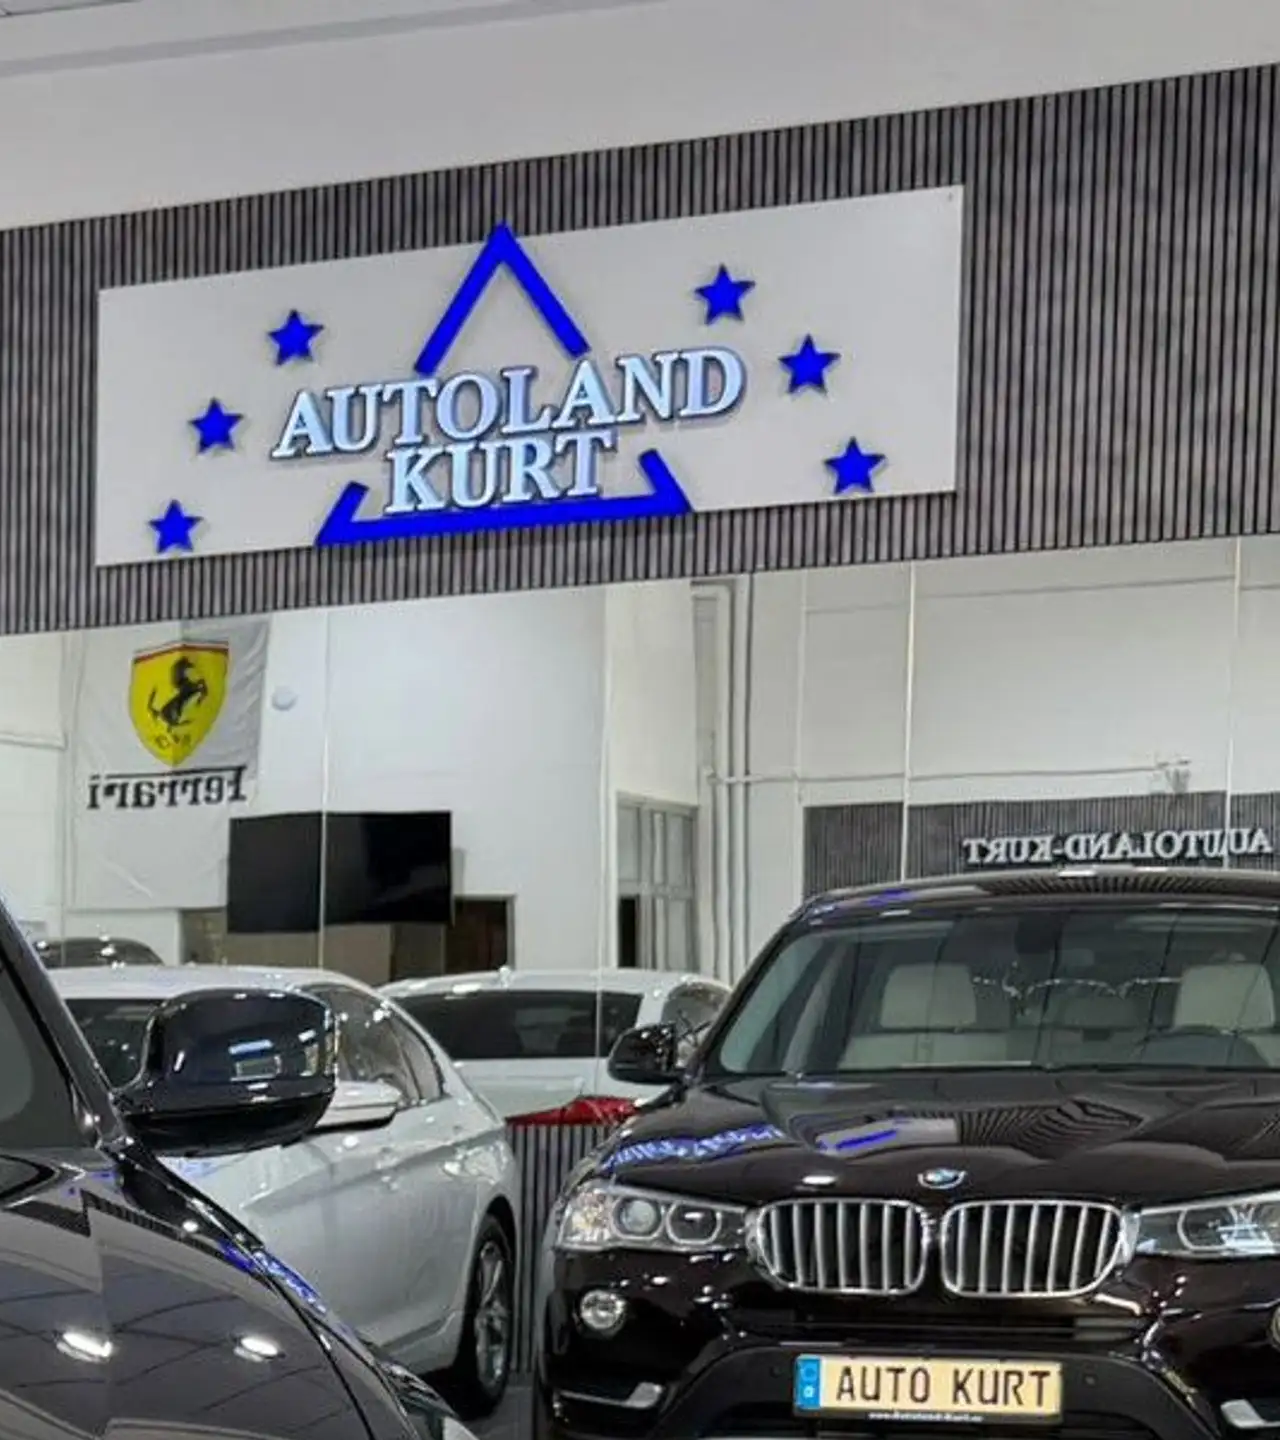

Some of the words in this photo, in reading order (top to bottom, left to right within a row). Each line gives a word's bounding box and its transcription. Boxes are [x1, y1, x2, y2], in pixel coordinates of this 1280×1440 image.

[272, 349, 744, 458] AUTOLAND
[385, 430, 616, 515] KURT
[836, 1365, 931, 1404] AUTO
[953, 1368, 1051, 1408] KURT
